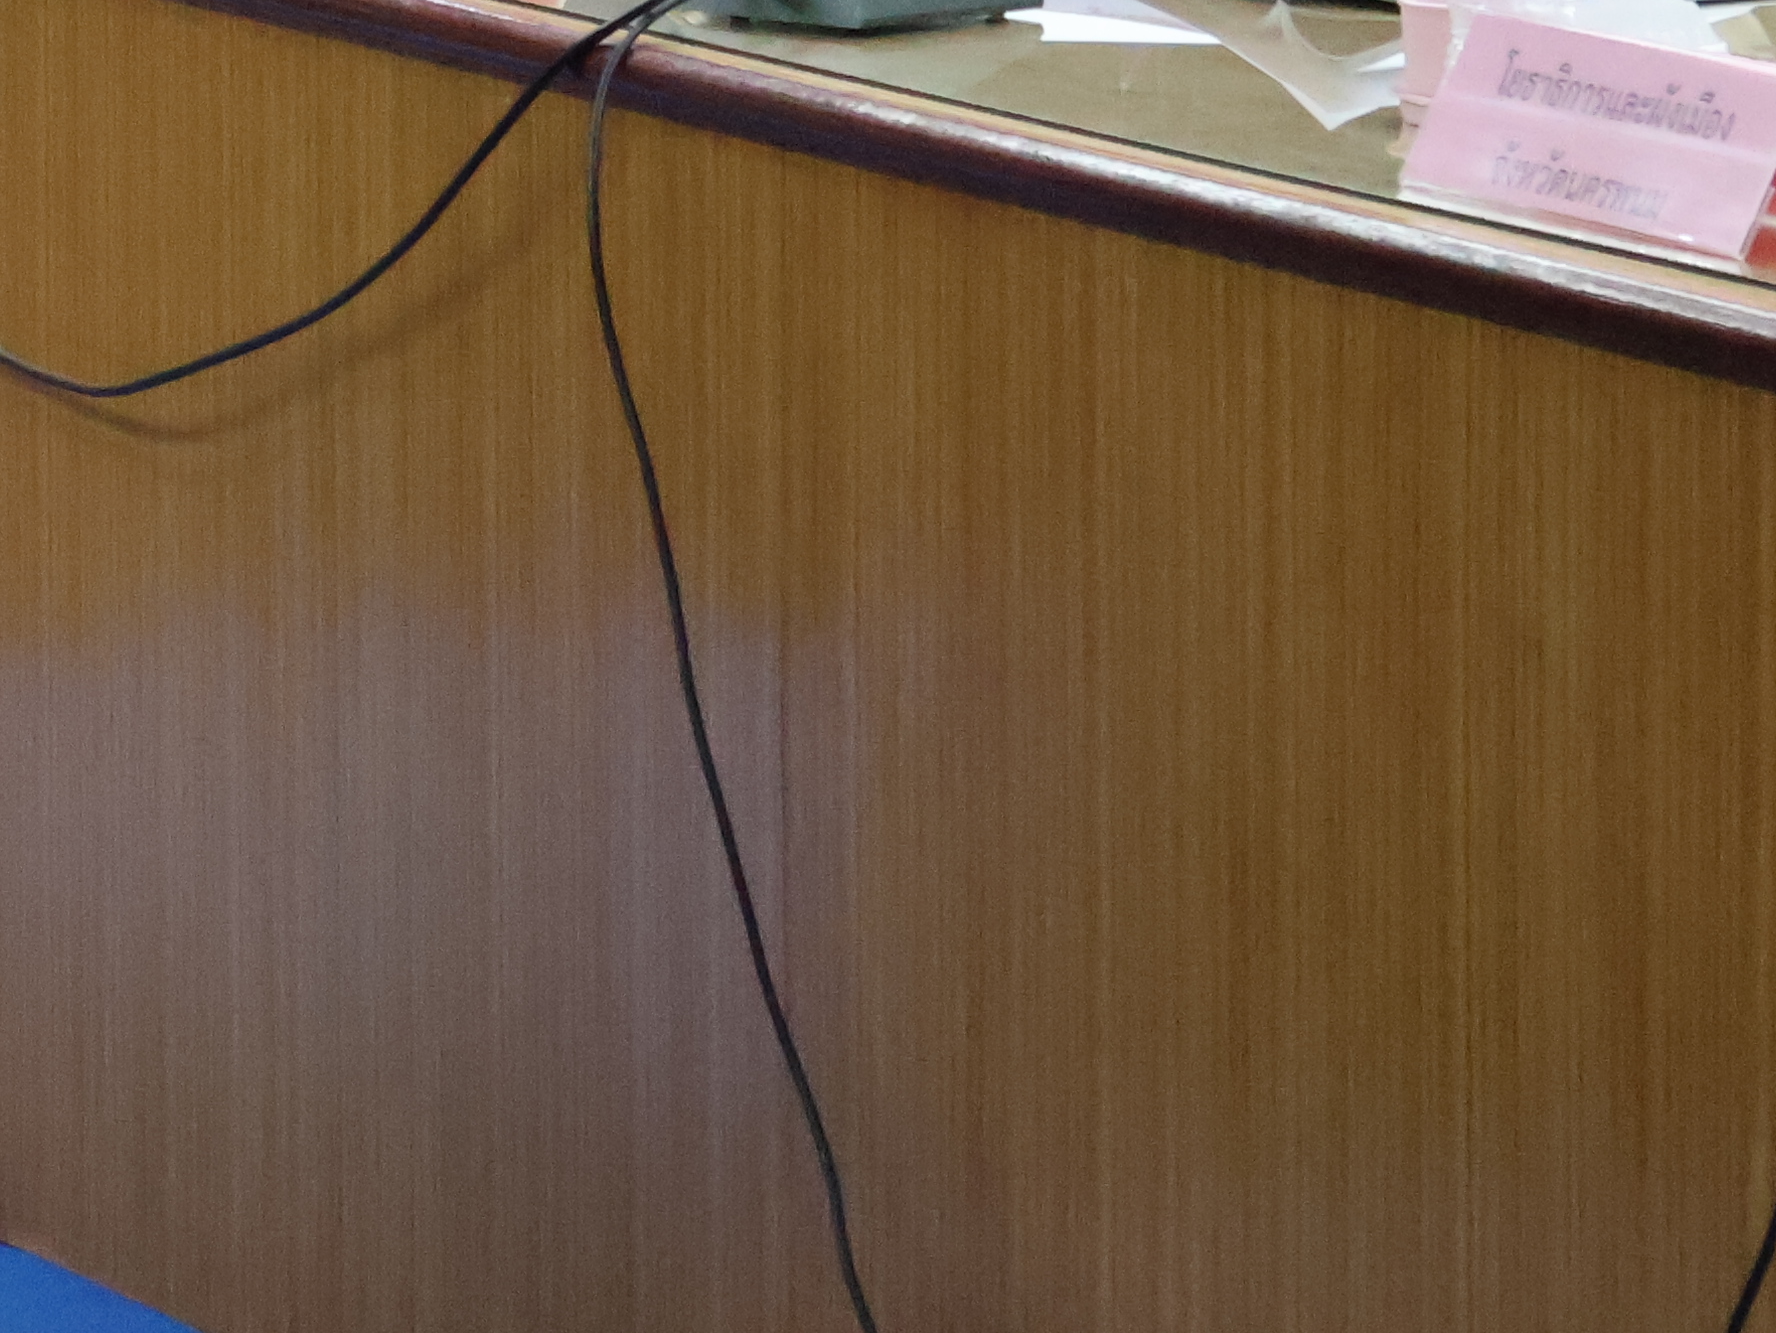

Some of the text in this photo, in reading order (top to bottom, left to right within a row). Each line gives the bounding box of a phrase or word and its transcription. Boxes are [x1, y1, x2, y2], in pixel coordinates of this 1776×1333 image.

[1497, 48, 1737, 142] โยธาธิการและผังเมือง
